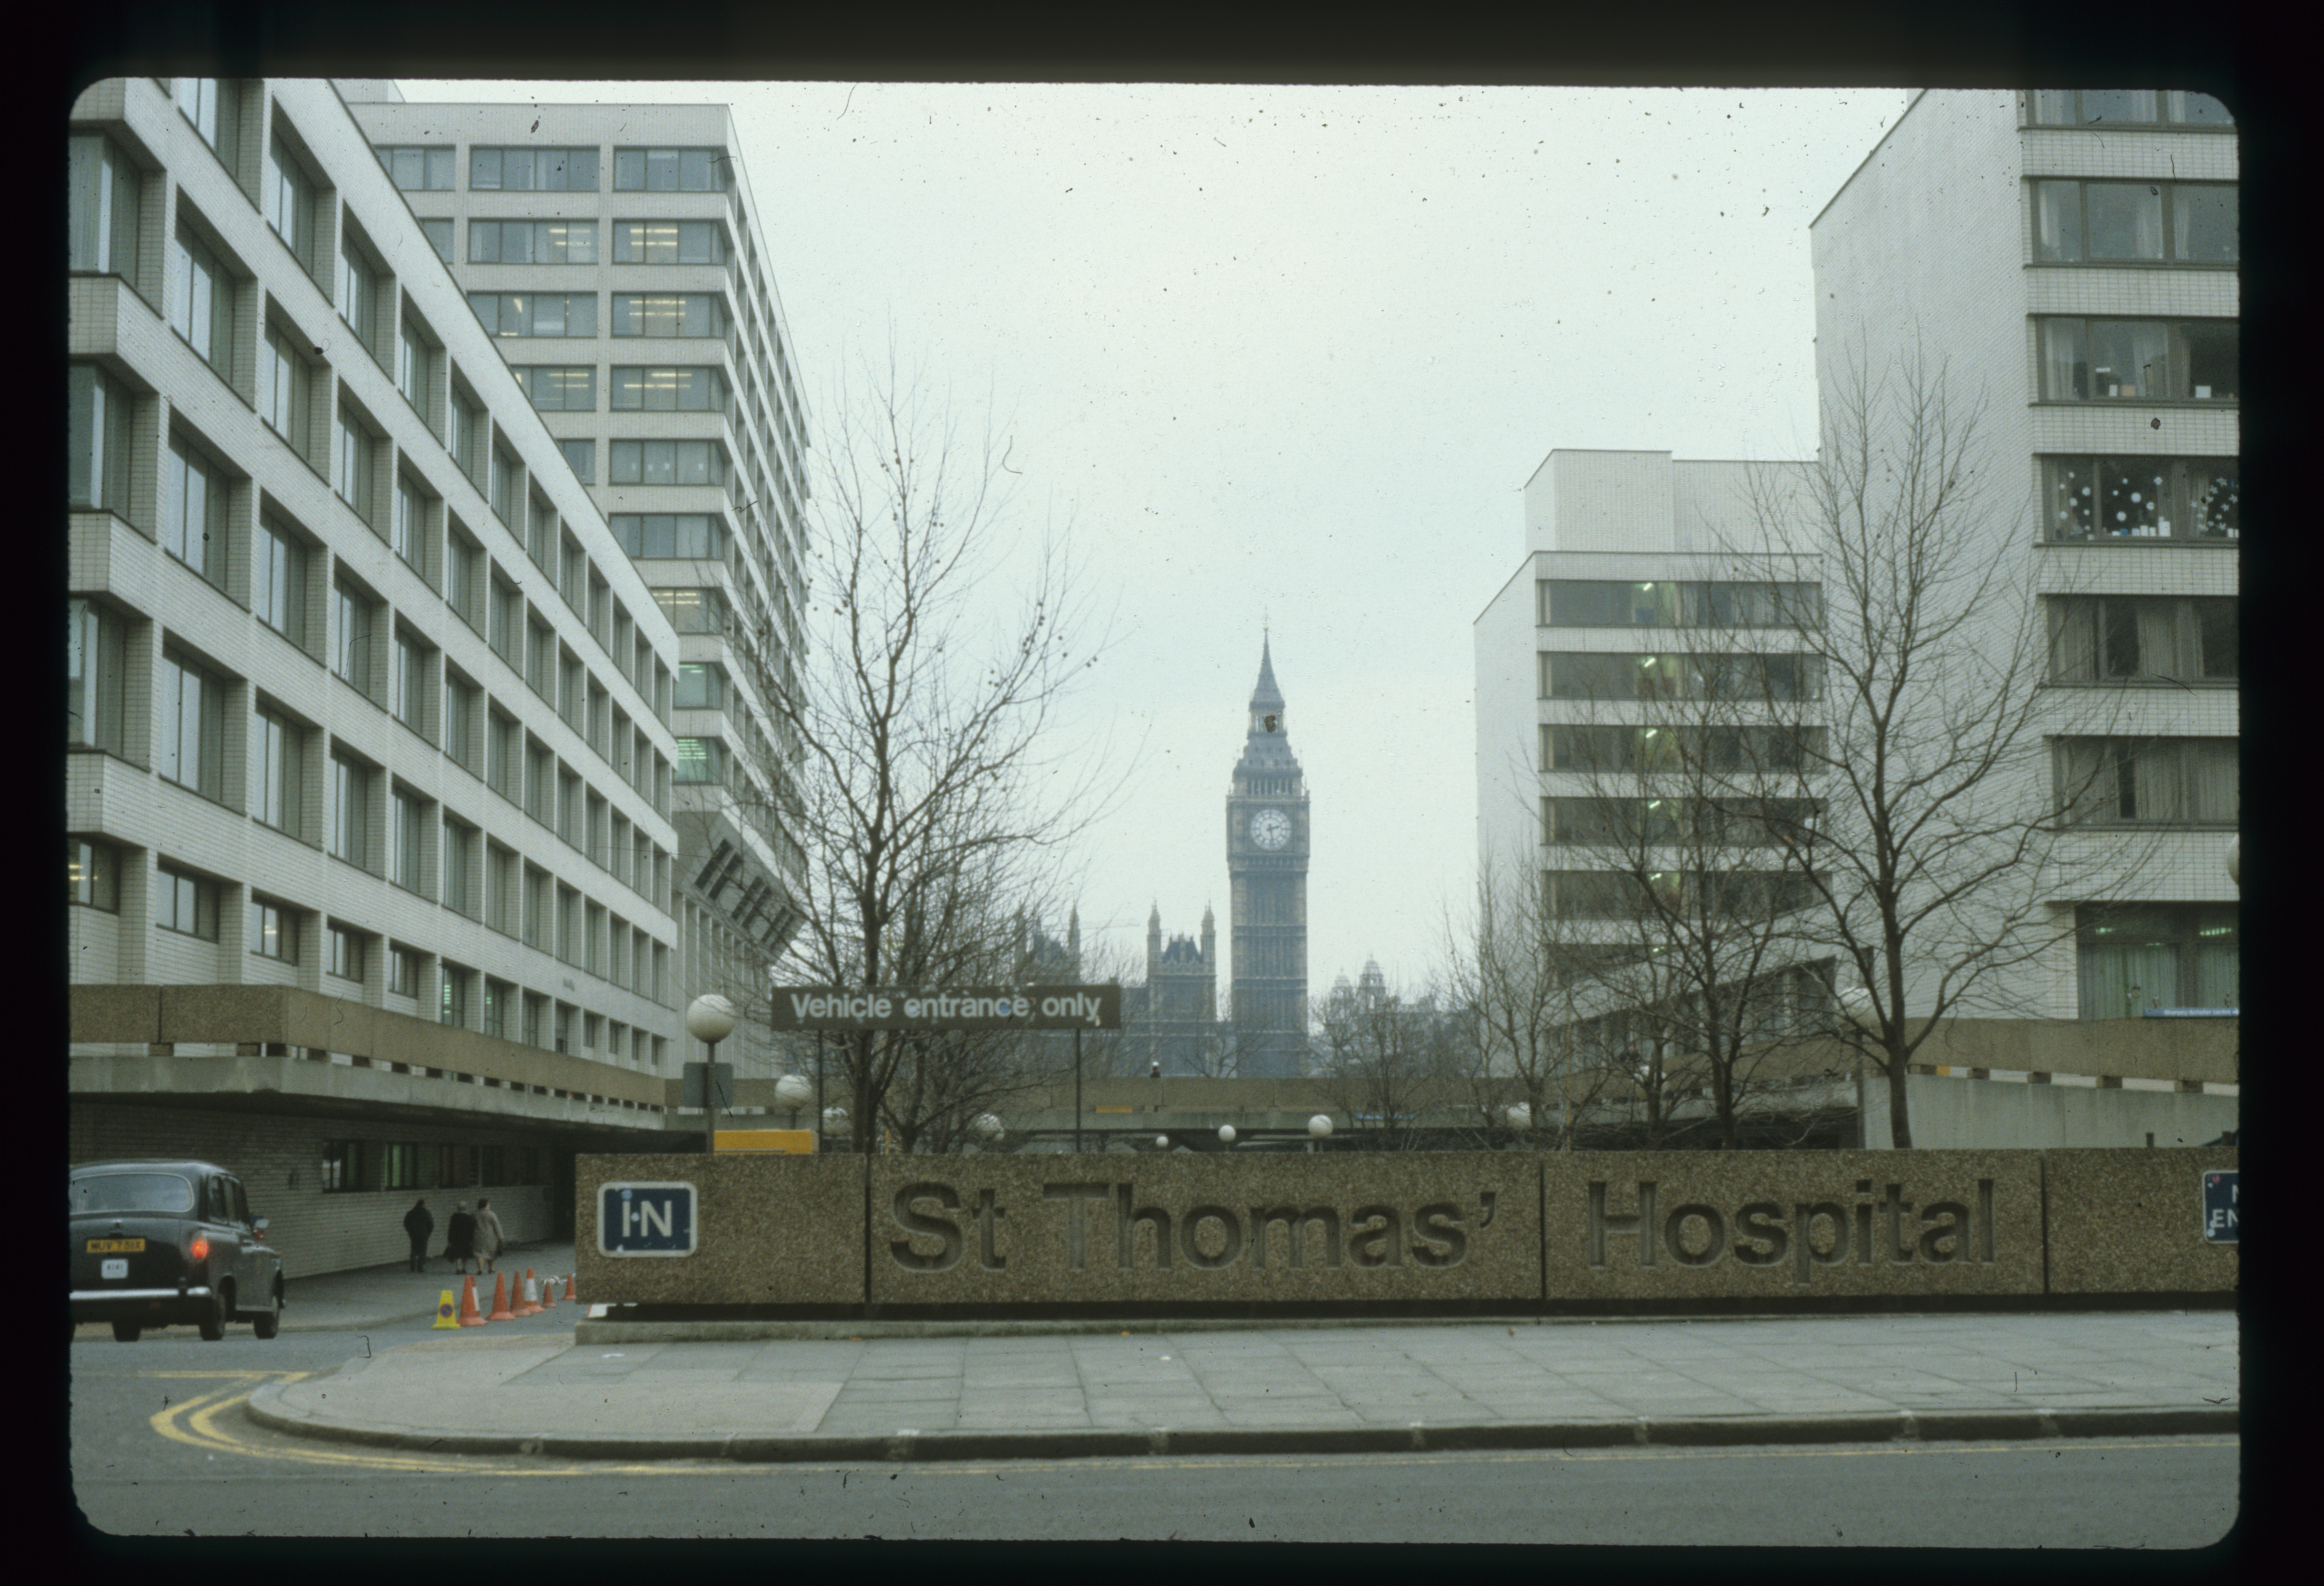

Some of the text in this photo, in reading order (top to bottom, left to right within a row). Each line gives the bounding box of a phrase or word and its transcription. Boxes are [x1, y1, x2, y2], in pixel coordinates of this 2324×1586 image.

[791, 992, 1101, 1021] Vehicle entrance only
[890, 1178, 1995, 1286] St Thomas' Hospital
